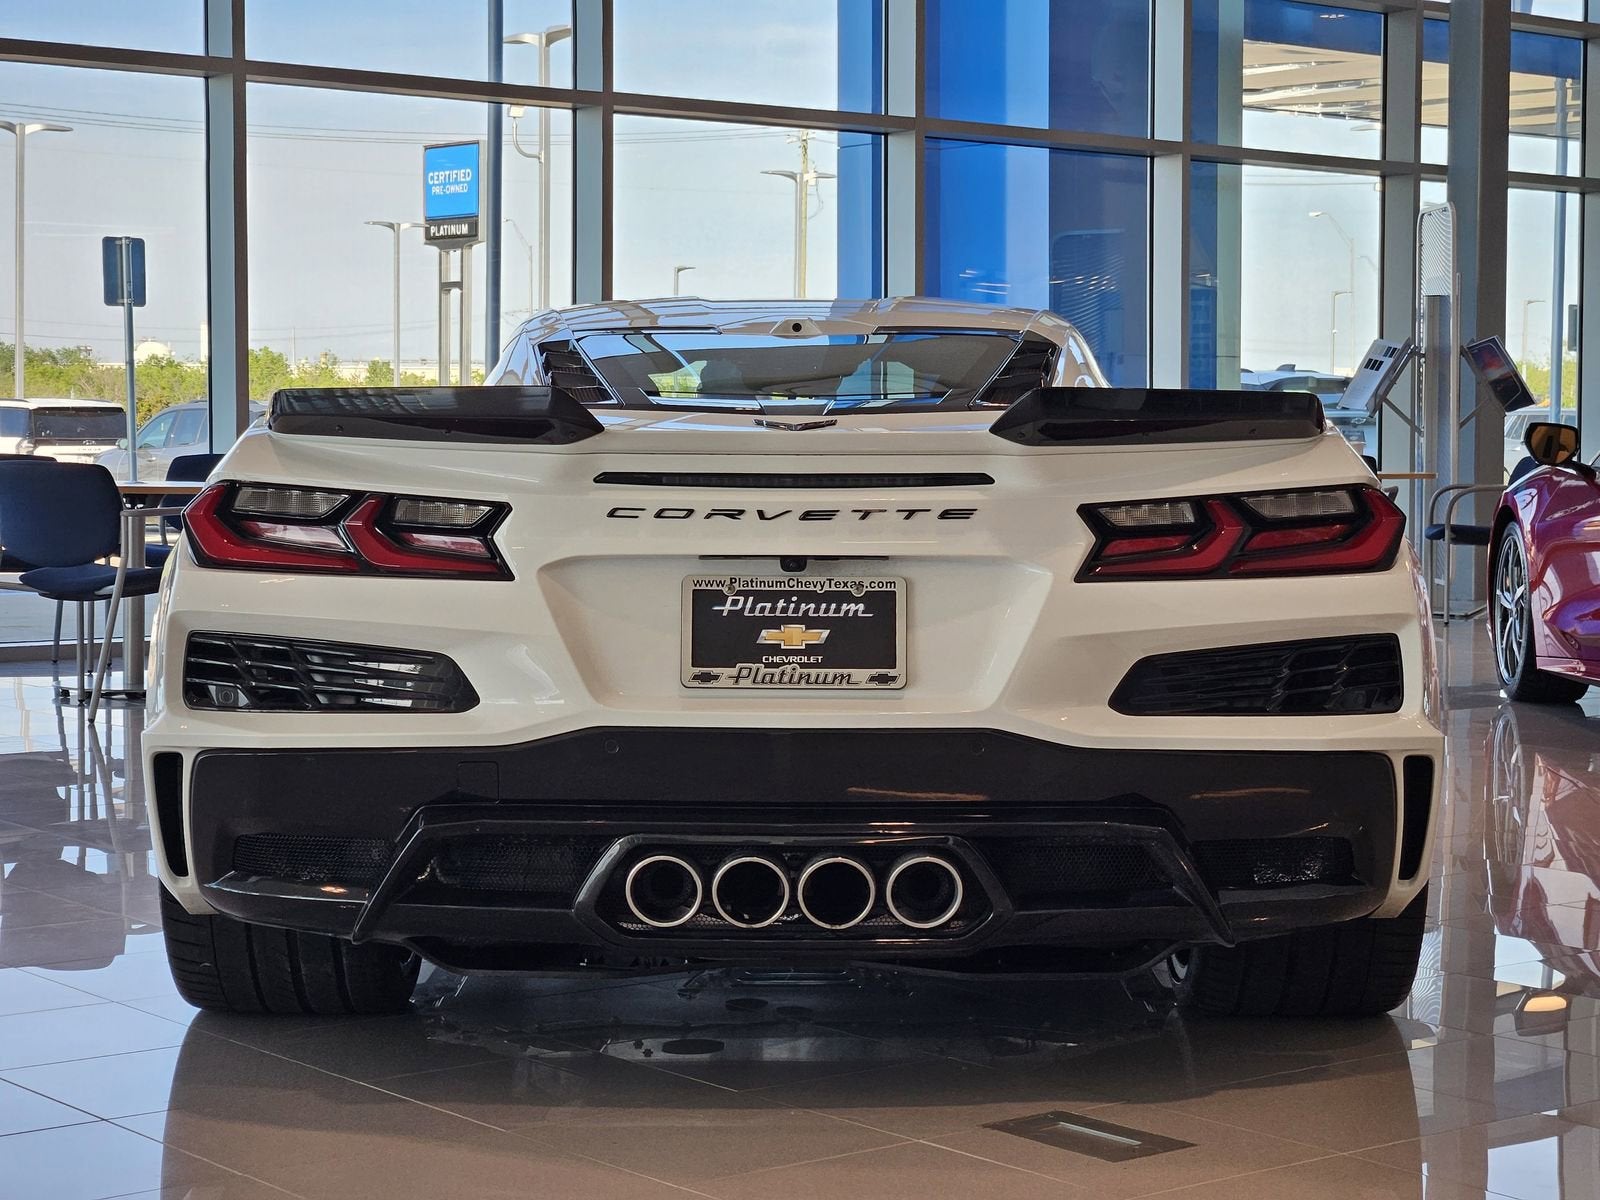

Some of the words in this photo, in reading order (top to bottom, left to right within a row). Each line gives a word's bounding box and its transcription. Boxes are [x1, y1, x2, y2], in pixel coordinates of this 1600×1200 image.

[428, 169, 472, 184] CERTIFIED
[431, 184, 469, 195] PRE-OWNED
[430, 224, 469, 236] PLATINUM
[606, 507, 978, 521] CORVETTE
[712, 596, 874, 617] Platinum
[762, 655, 823, 663] CHEVROLET
[726, 666, 862, 686] Platinum
